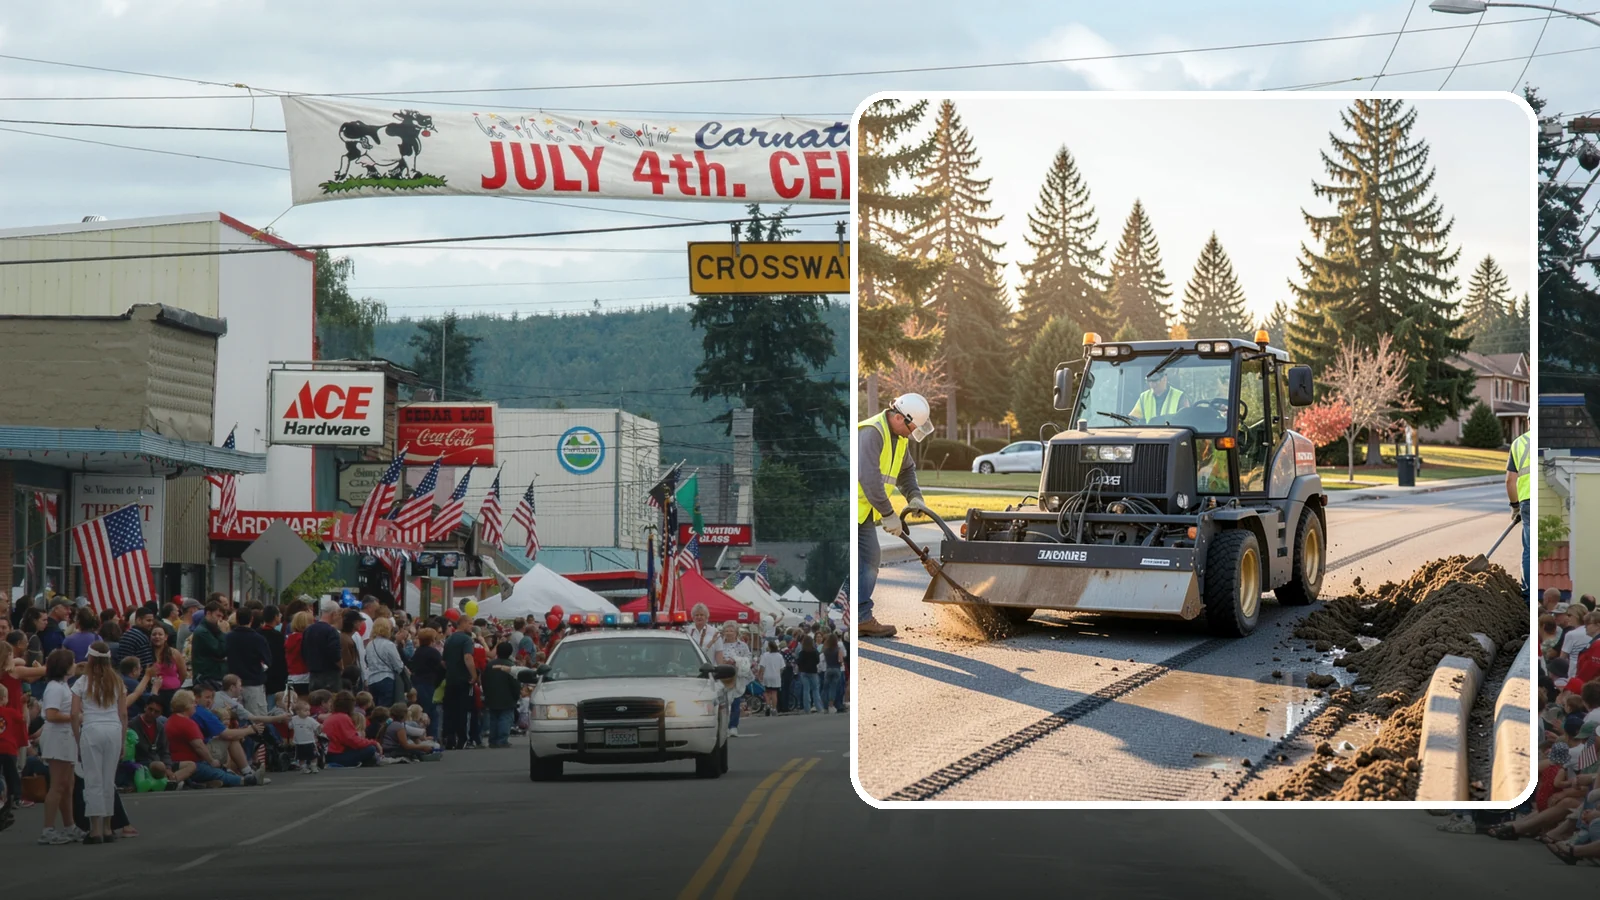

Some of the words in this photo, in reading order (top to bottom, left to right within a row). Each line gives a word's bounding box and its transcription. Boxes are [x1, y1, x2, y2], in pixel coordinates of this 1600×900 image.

[481, 141, 605, 192] JULY
[632, 150, 746, 197] 4th.
[697, 254, 850, 279] CROSSWA
[283, 380, 374, 420] ACE
[406, 409, 452, 421] CEDAR
[461, 409, 485, 421] LOG
[283, 421, 371, 437] Hardware
[416, 428, 477, 447] Coca-Cola
[353, 467, 384, 480] Simpl
[83, 484, 93, 494] St.
[95, 485, 124, 495] Vincent
[126, 486, 135, 495] de
[138, 486, 155, 495] Paul
[212, 516, 331, 536] HARDARE
[688, 526, 742, 535] CRNATION
[699, 535, 730, 544] GLASS
